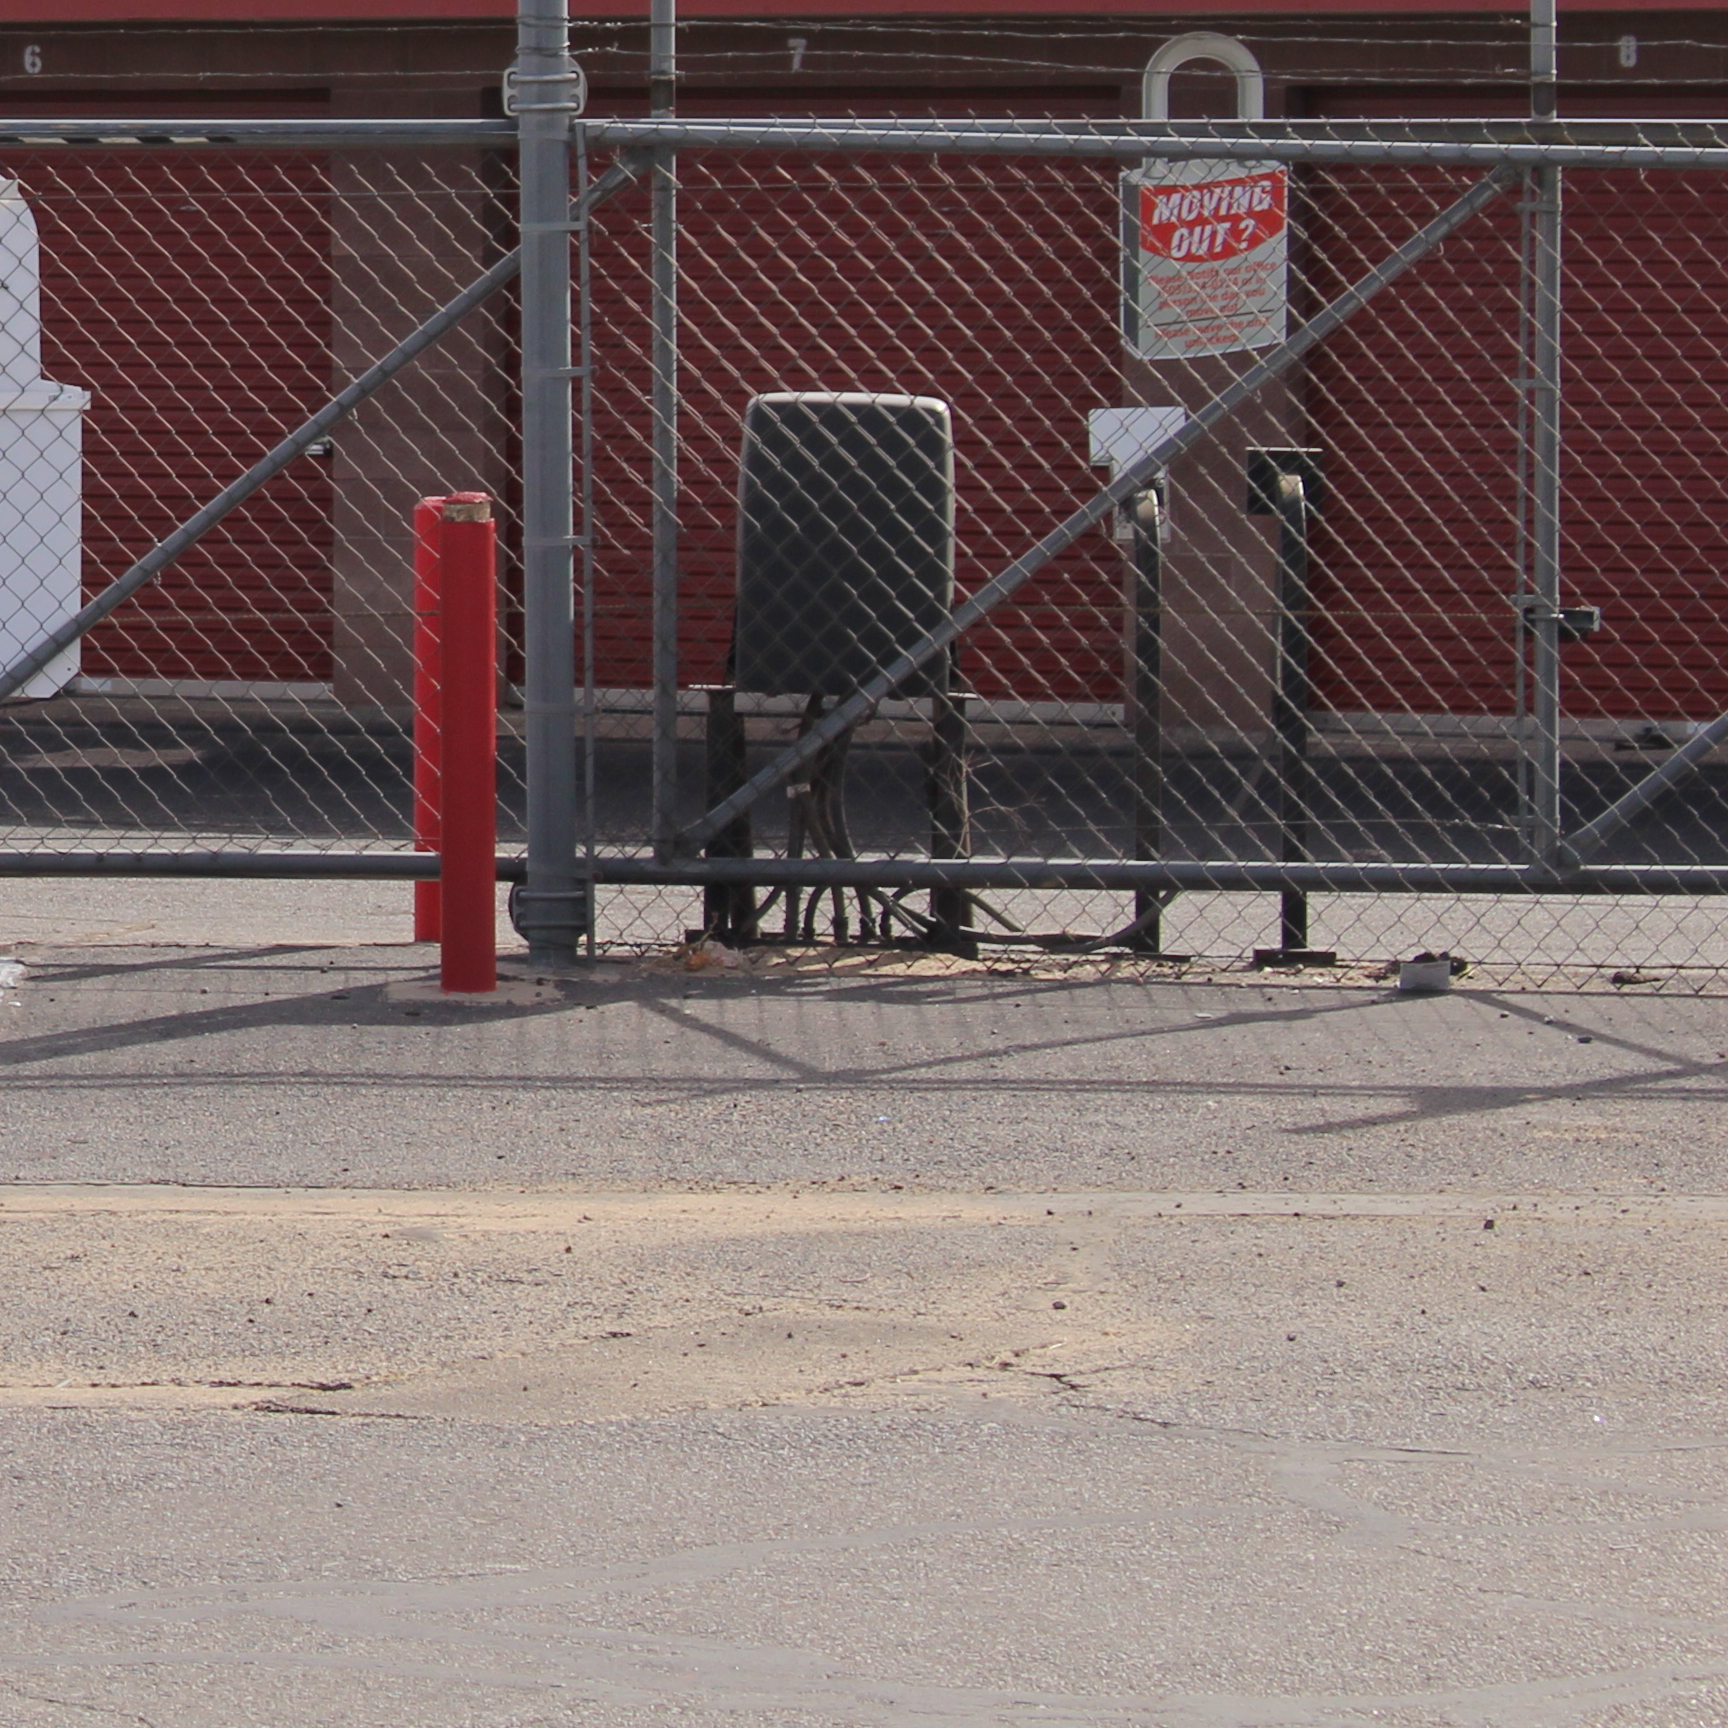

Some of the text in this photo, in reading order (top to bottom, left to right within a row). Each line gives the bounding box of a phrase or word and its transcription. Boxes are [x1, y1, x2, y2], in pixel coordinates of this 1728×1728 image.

[24, 45, 42, 74] 6
[788, 39, 807, 70] 7
[1619, 35, 1637, 67] 8
[1152, 180, 1272, 225] MOVING
